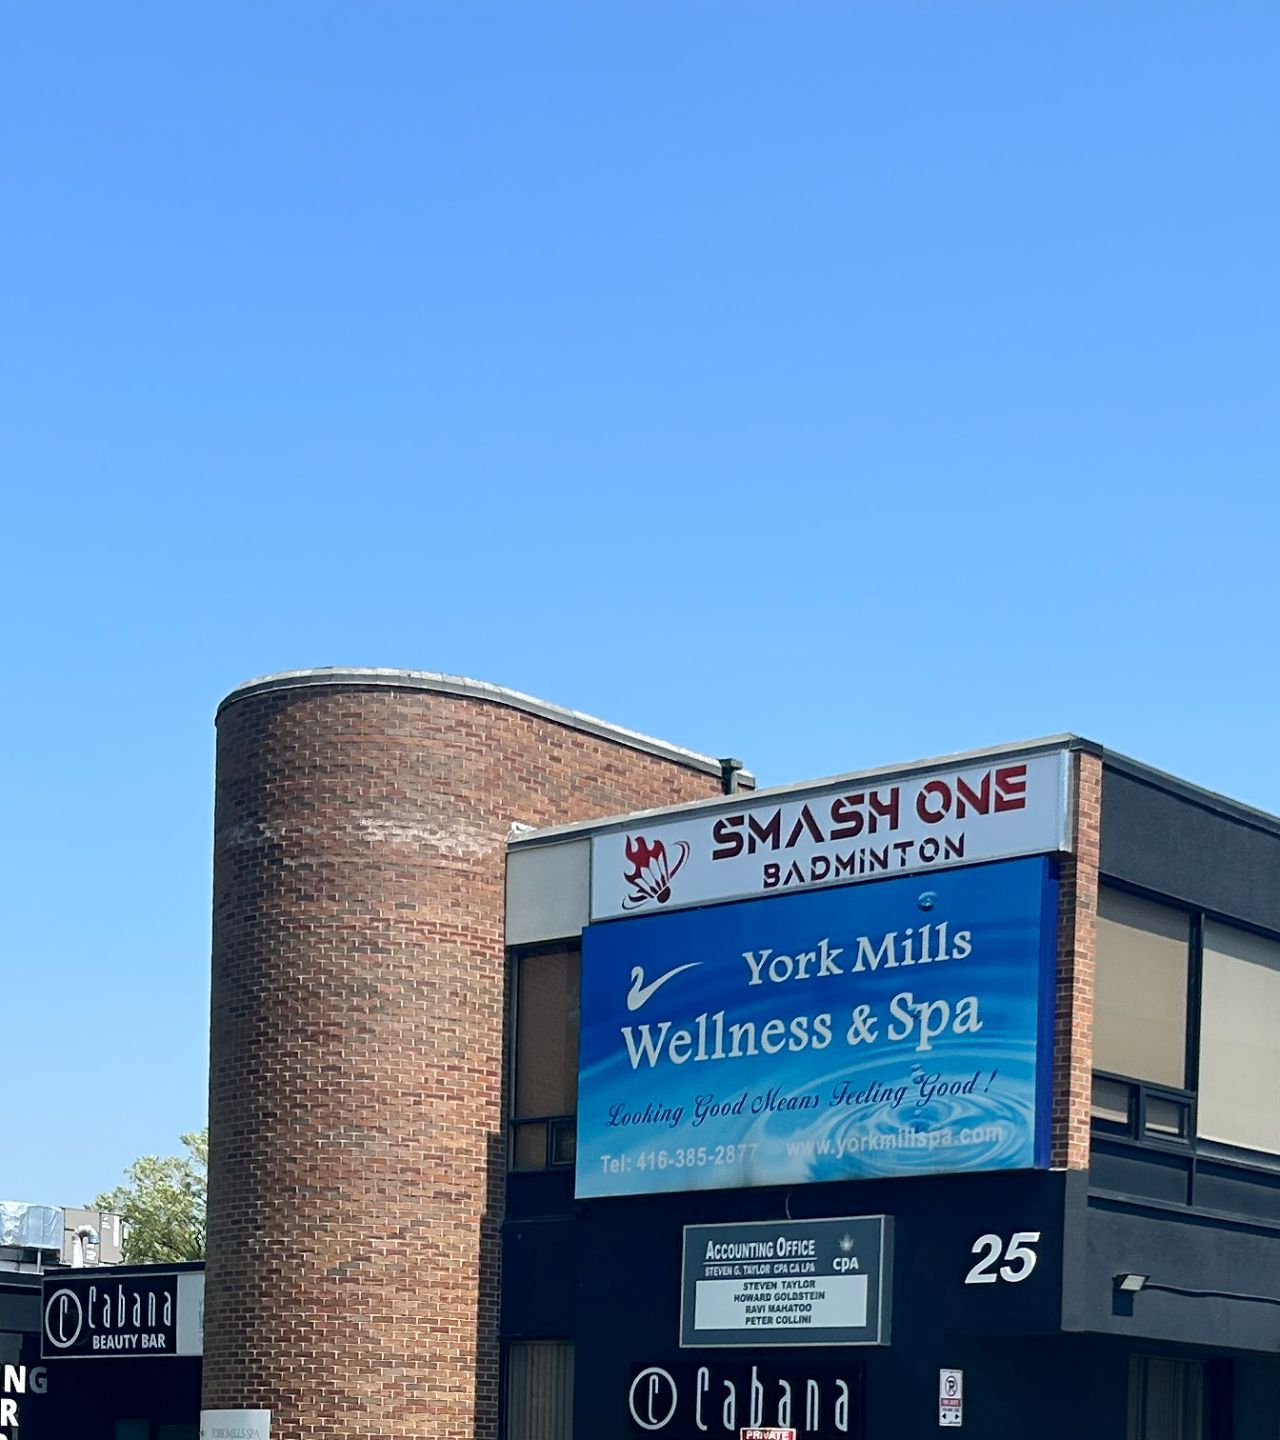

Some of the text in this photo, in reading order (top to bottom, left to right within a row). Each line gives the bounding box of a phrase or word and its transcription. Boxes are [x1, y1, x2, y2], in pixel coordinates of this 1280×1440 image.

[712, 765, 1028, 861] SMASH ONE
[763, 832, 966, 889] BADMINTON
[742, 921, 972, 985] York Mills
[621, 992, 983, 1069] Wellness & Spa
[605, 1102, 684, 1128] Looking
[691, 1093, 748, 1127] Good
[751, 1087, 820, 1114] Means
[829, 1080, 907, 1108] Feeling
[916, 1070, 981, 1107] Good
[601, 1127, 1003, 1174] Tel: 416-385-2877 www.yorkmillspa.com
[705, 1265, 733, 1277] STEVEN
[743, 1264, 770, 1275] TAYLOR
[774, 1263, 788, 1274] CPA
[965, 1231, 1041, 1284] 25
[88, 1284, 172, 1329] Cabana
[734, 1291, 825, 1303] HOWARD GOLDSTEIN
[743, 1280, 816, 1291] STEVEN TAYLOR
[745, 1303, 812, 1314] RAVI MAHATOO
[92, 1333, 166, 1349] BEAUTY BAR
[745, 1315, 812, 1326] PETER COLLINI
[696, 1366, 849, 1432] Cabana
[746, 1430, 790, 1440] PRIVATE
